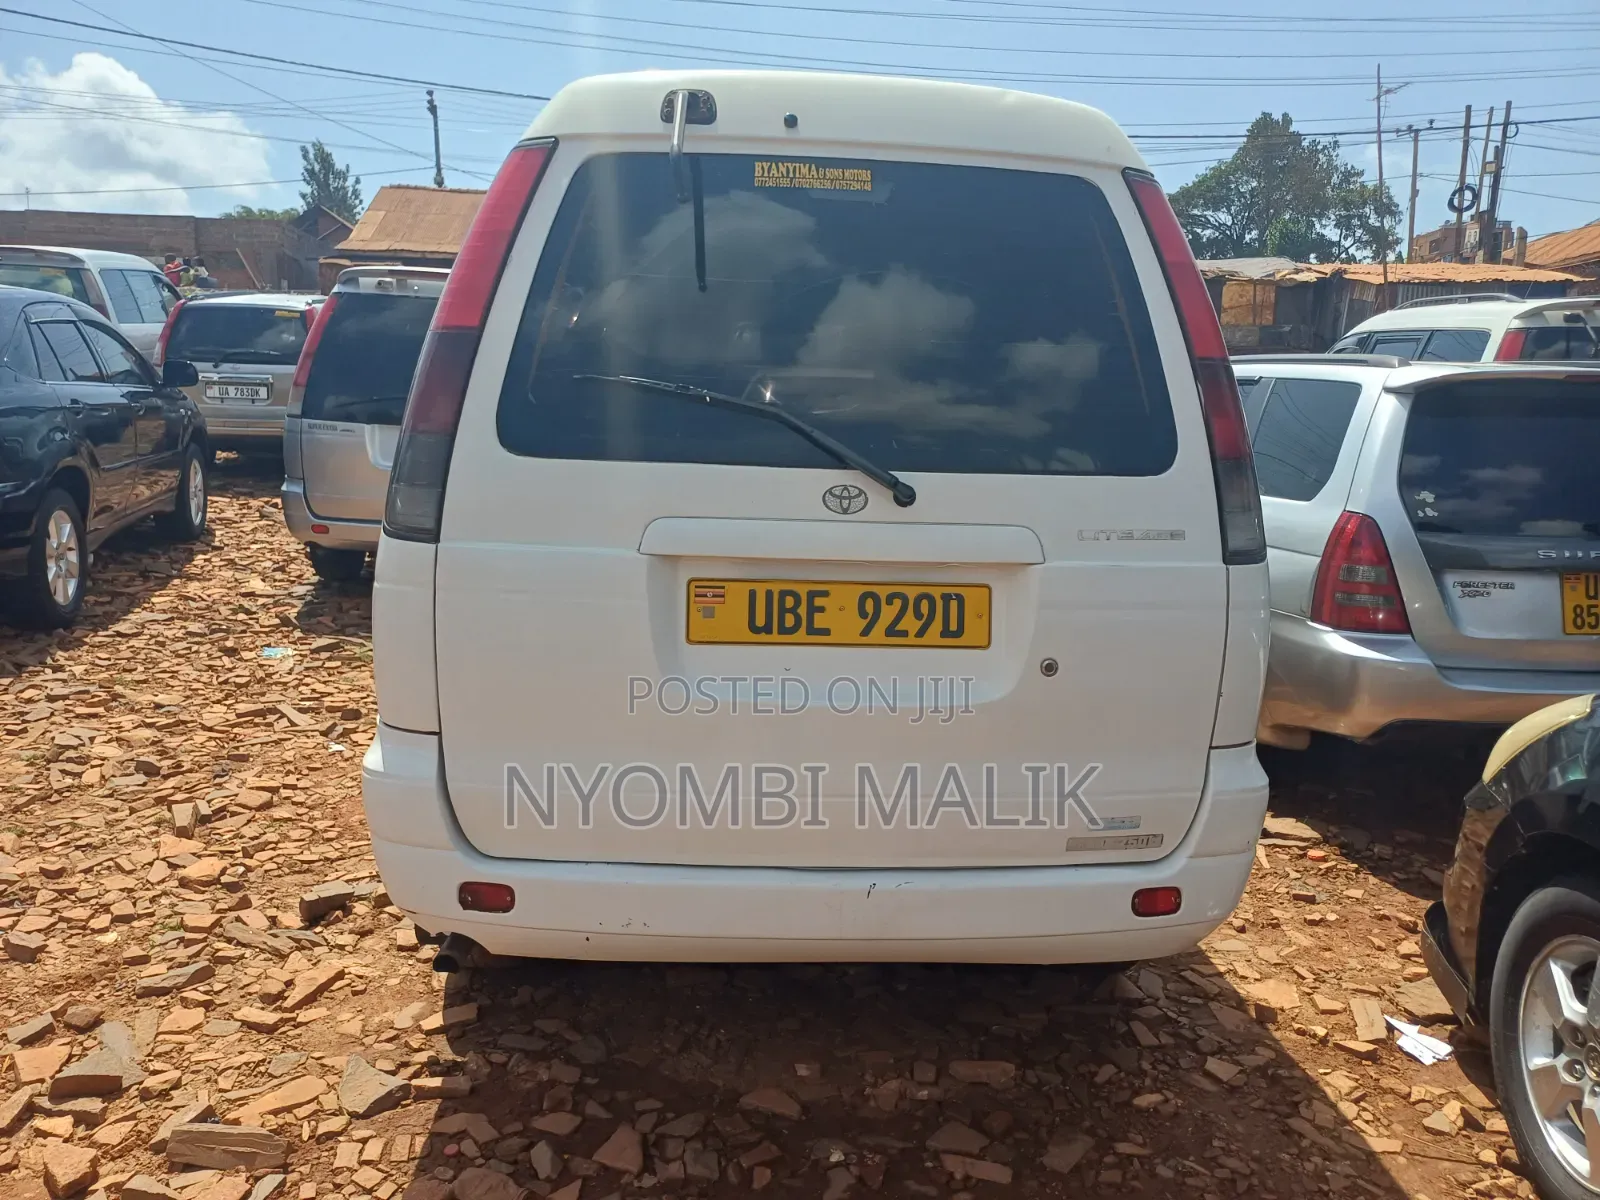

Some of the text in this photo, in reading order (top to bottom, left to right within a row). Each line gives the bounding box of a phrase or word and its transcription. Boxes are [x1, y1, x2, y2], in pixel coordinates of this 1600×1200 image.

[754, 161, 818, 179] BYANYIMA
[825, 168, 843, 180] SONS
[844, 169, 872, 181] MOTORS
[218, 386, 230, 397] UA
[1453, 581, 1515, 590] FORESTER
[748, 589, 966, 639] UBE 929D
